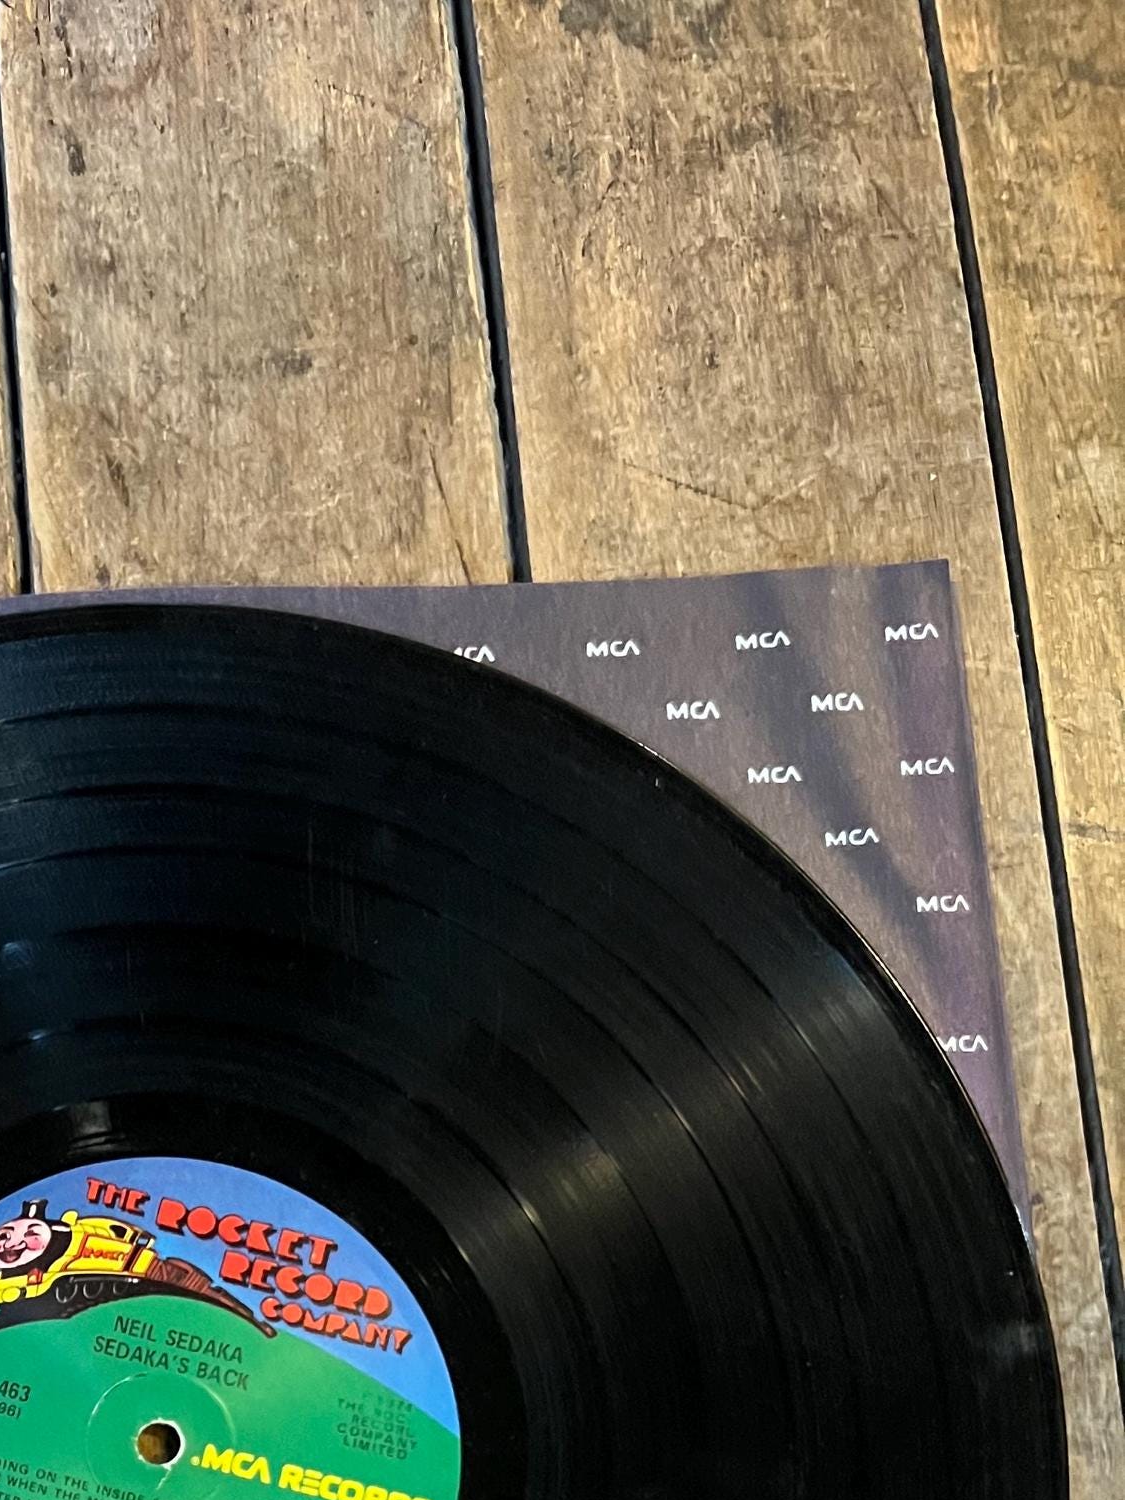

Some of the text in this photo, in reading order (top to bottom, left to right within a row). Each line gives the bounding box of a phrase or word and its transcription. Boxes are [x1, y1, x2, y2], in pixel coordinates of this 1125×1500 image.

[735, 631, 790, 650] MCA
[885, 623, 939, 641] MCA
[586, 640, 640, 657] MCA
[667, 701, 720, 720] MCA
[811, 693, 863, 712] MCA
[748, 766, 802, 783] MCA
[901, 757, 954, 775] MCA
[825, 828, 879, 847] MCA
[917, 895, 969, 912] MCA
[87, 1177, 337, 1268] THE ROCKET
[219, 1249, 391, 1319] RECORD
[259, 1296, 413, 1354] COMPANY
[113, 1315, 244, 1364] NEIL SEDAKA
[92, 1335, 250, 1391] SEDAKA'S BACK
[336, 1421, 418, 1452] COMPANY
[342, 1434, 408, 1461] LIMITED
[6, 1475, 48, 1495] WHEN
[34, 1467, 57, 1483] ON
[63, 1475, 89, 1491] THE
